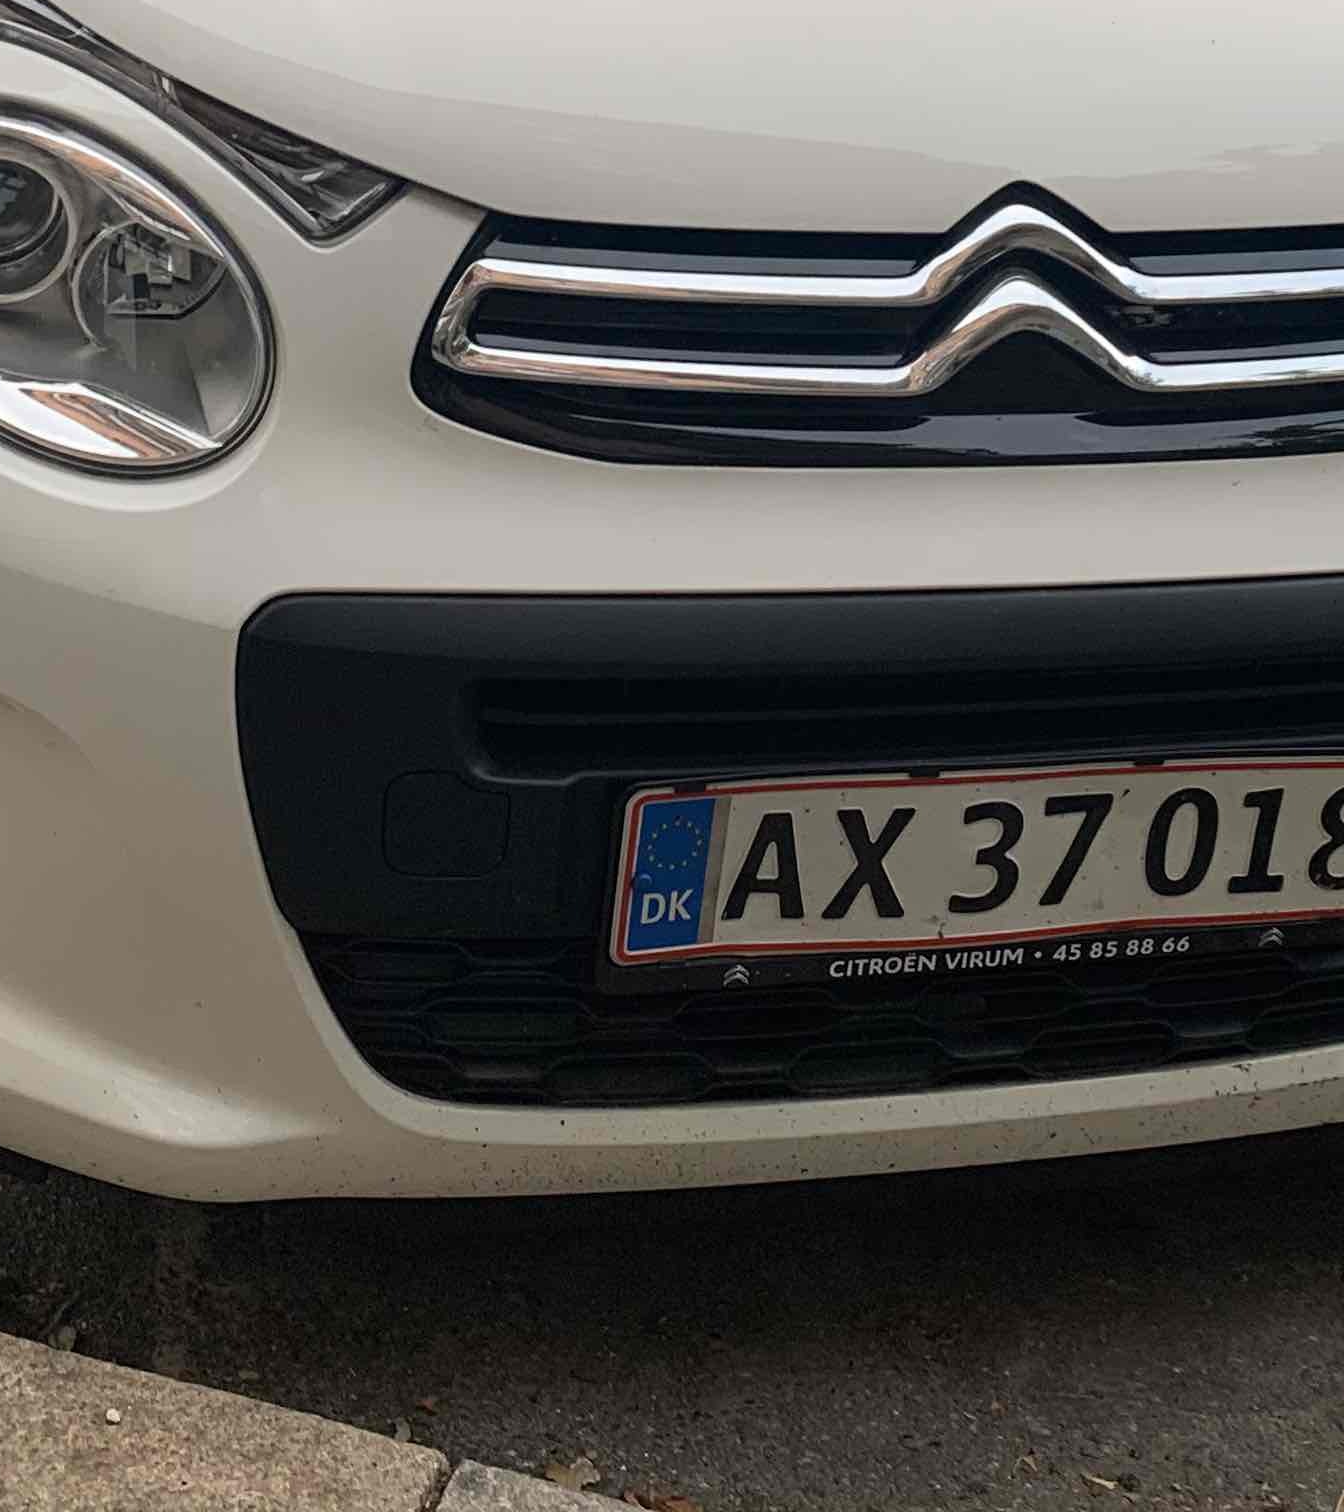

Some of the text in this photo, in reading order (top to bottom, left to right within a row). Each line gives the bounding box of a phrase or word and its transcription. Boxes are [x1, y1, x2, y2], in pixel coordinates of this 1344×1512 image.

[721, 808, 916, 920] AX
[948, 792, 1114, 913] 37
[640, 889, 693, 924] DK
[829, 936, 1190, 977] CITROËN VIRUM 45 85 88 66
